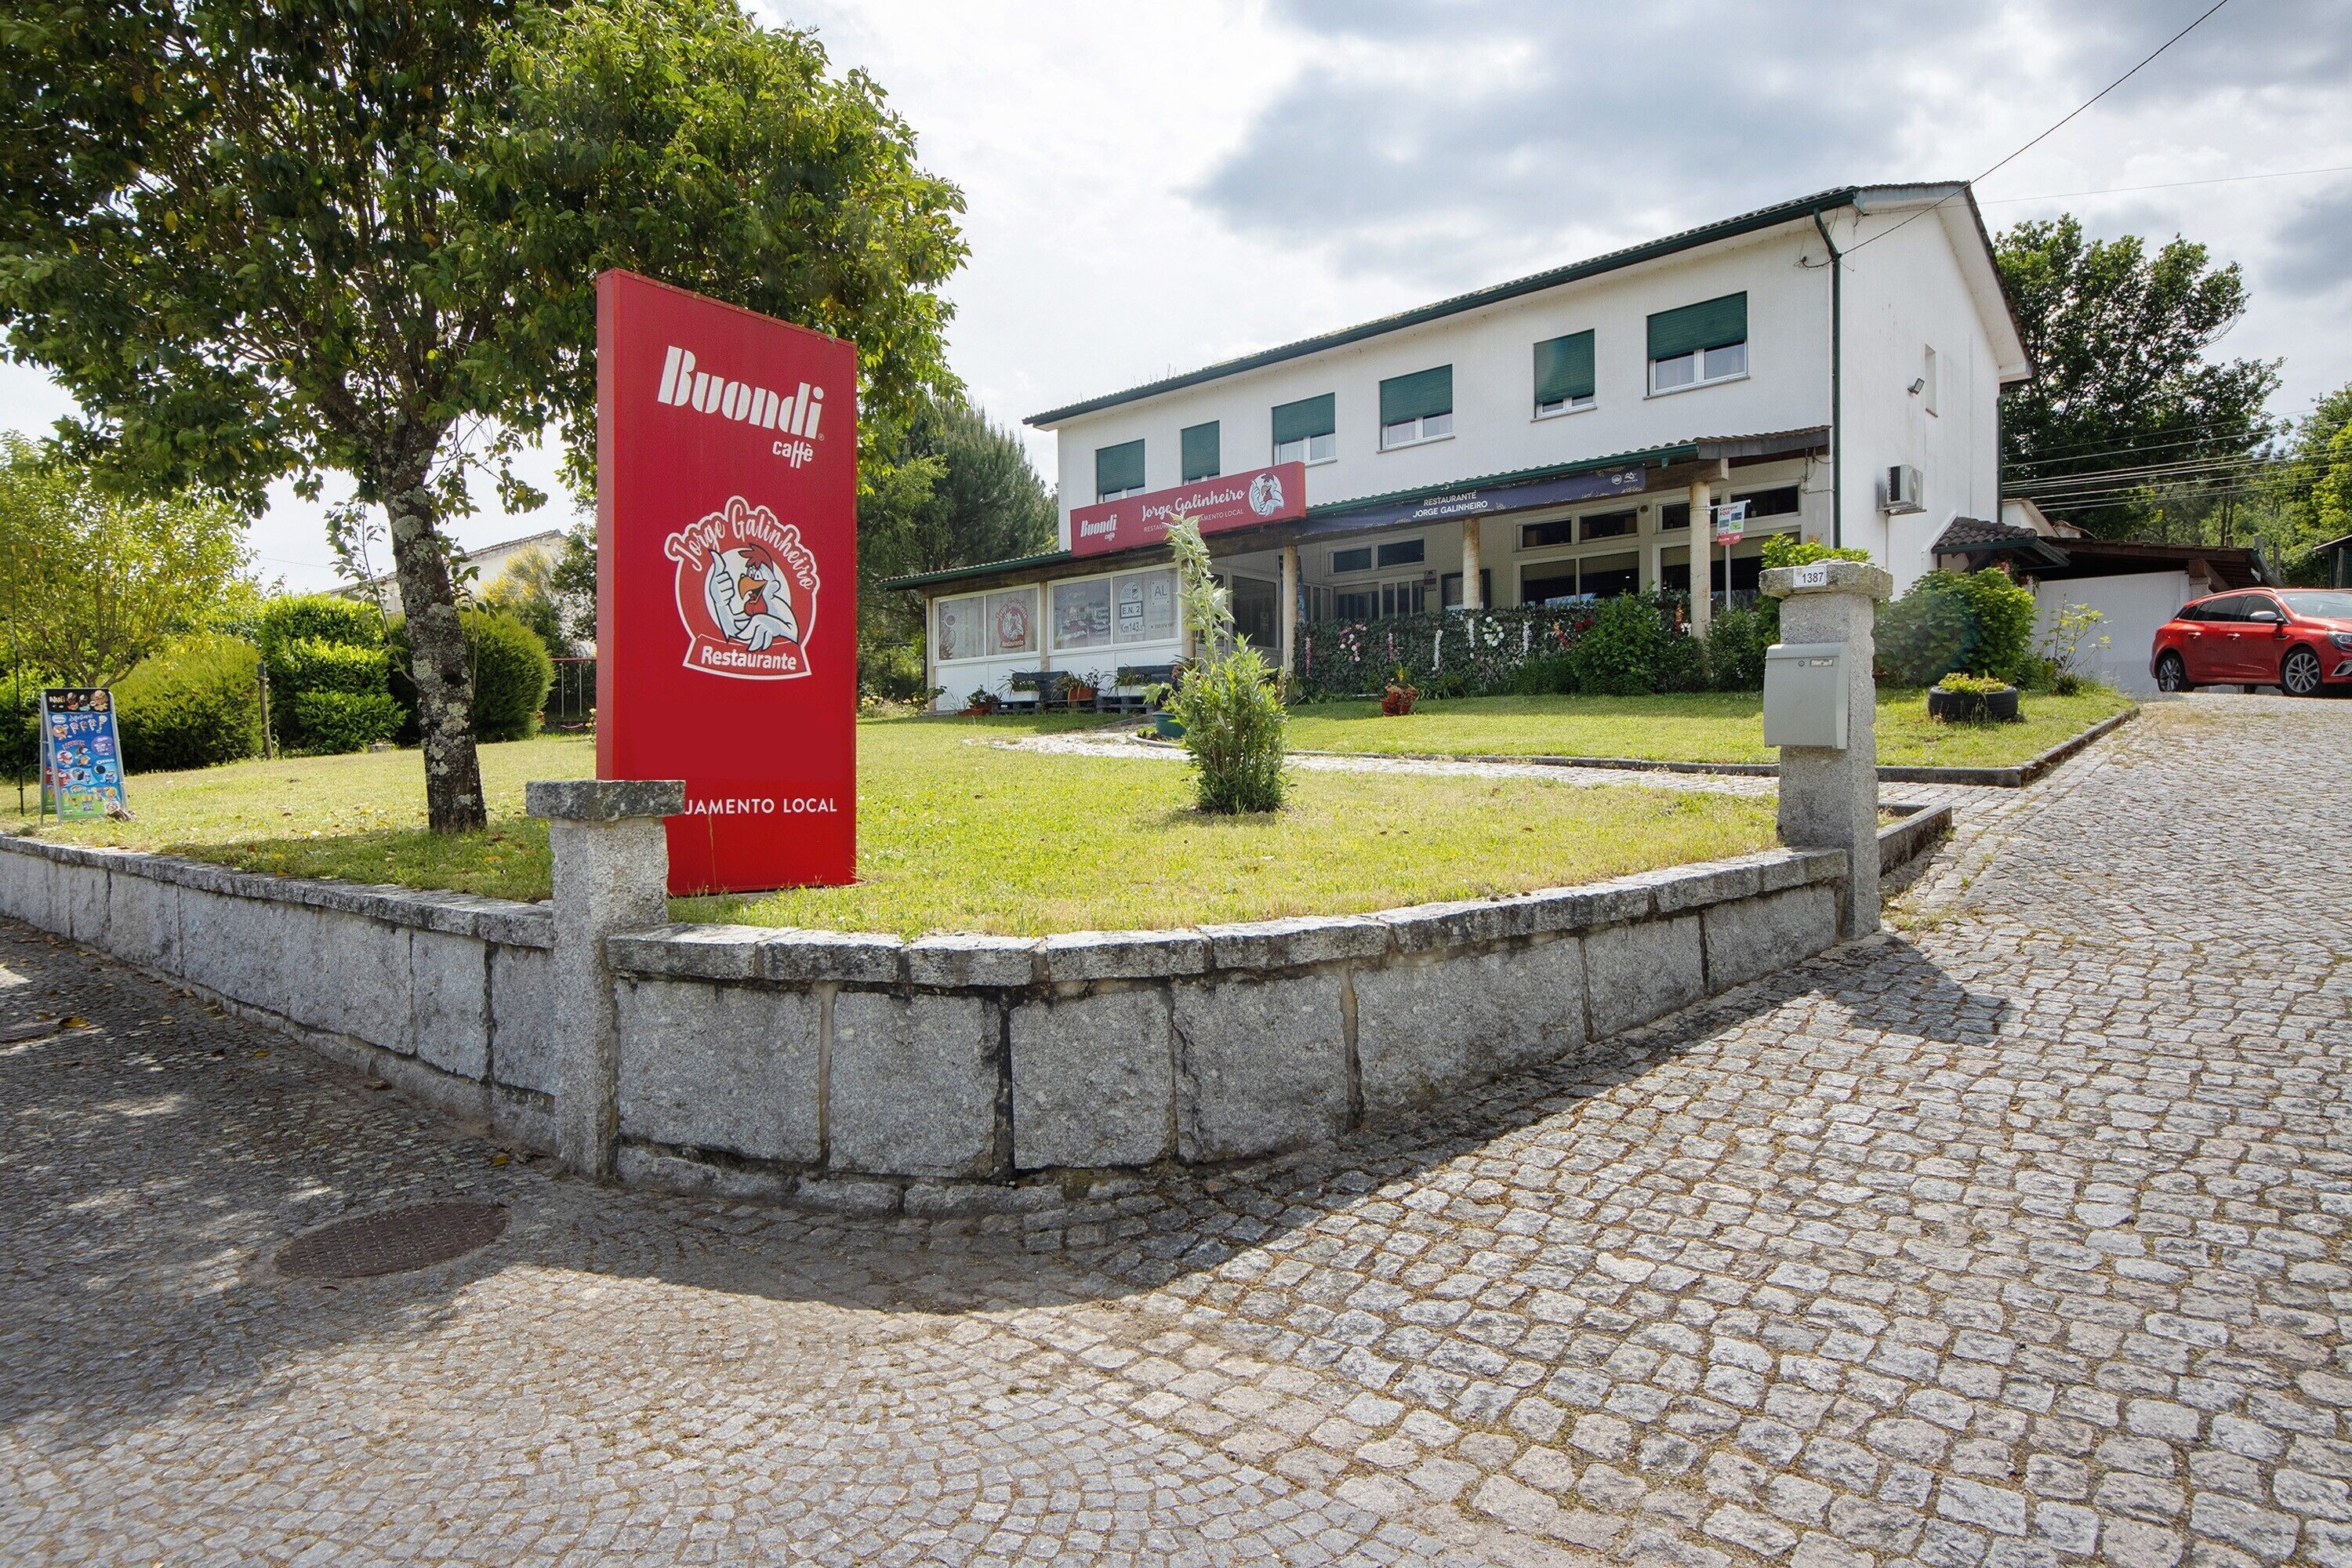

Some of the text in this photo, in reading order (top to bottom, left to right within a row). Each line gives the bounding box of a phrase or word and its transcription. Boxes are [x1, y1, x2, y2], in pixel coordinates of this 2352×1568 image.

[657, 345, 825, 440] Buondi
[772, 440, 813, 469] caffè
[1141, 488, 1247, 523] Jorge Galinheiro
[1423, 491, 1477, 506] RESTAURANTE
[1225, 508, 1244, 519] LOCAL
[1412, 499, 1489, 519] JORGE GALINHEIRO
[1080, 514, 1118, 539] Buondi
[672, 503, 814, 590] Jorge Galinheiro
[1802, 572, 1824, 584] 1387
[1154, 586, 1168, 597] AL
[1136, 605, 1141, 614] 2
[701, 645, 797, 670] Restaurante
[783, 797, 838, 814] LOCAL
